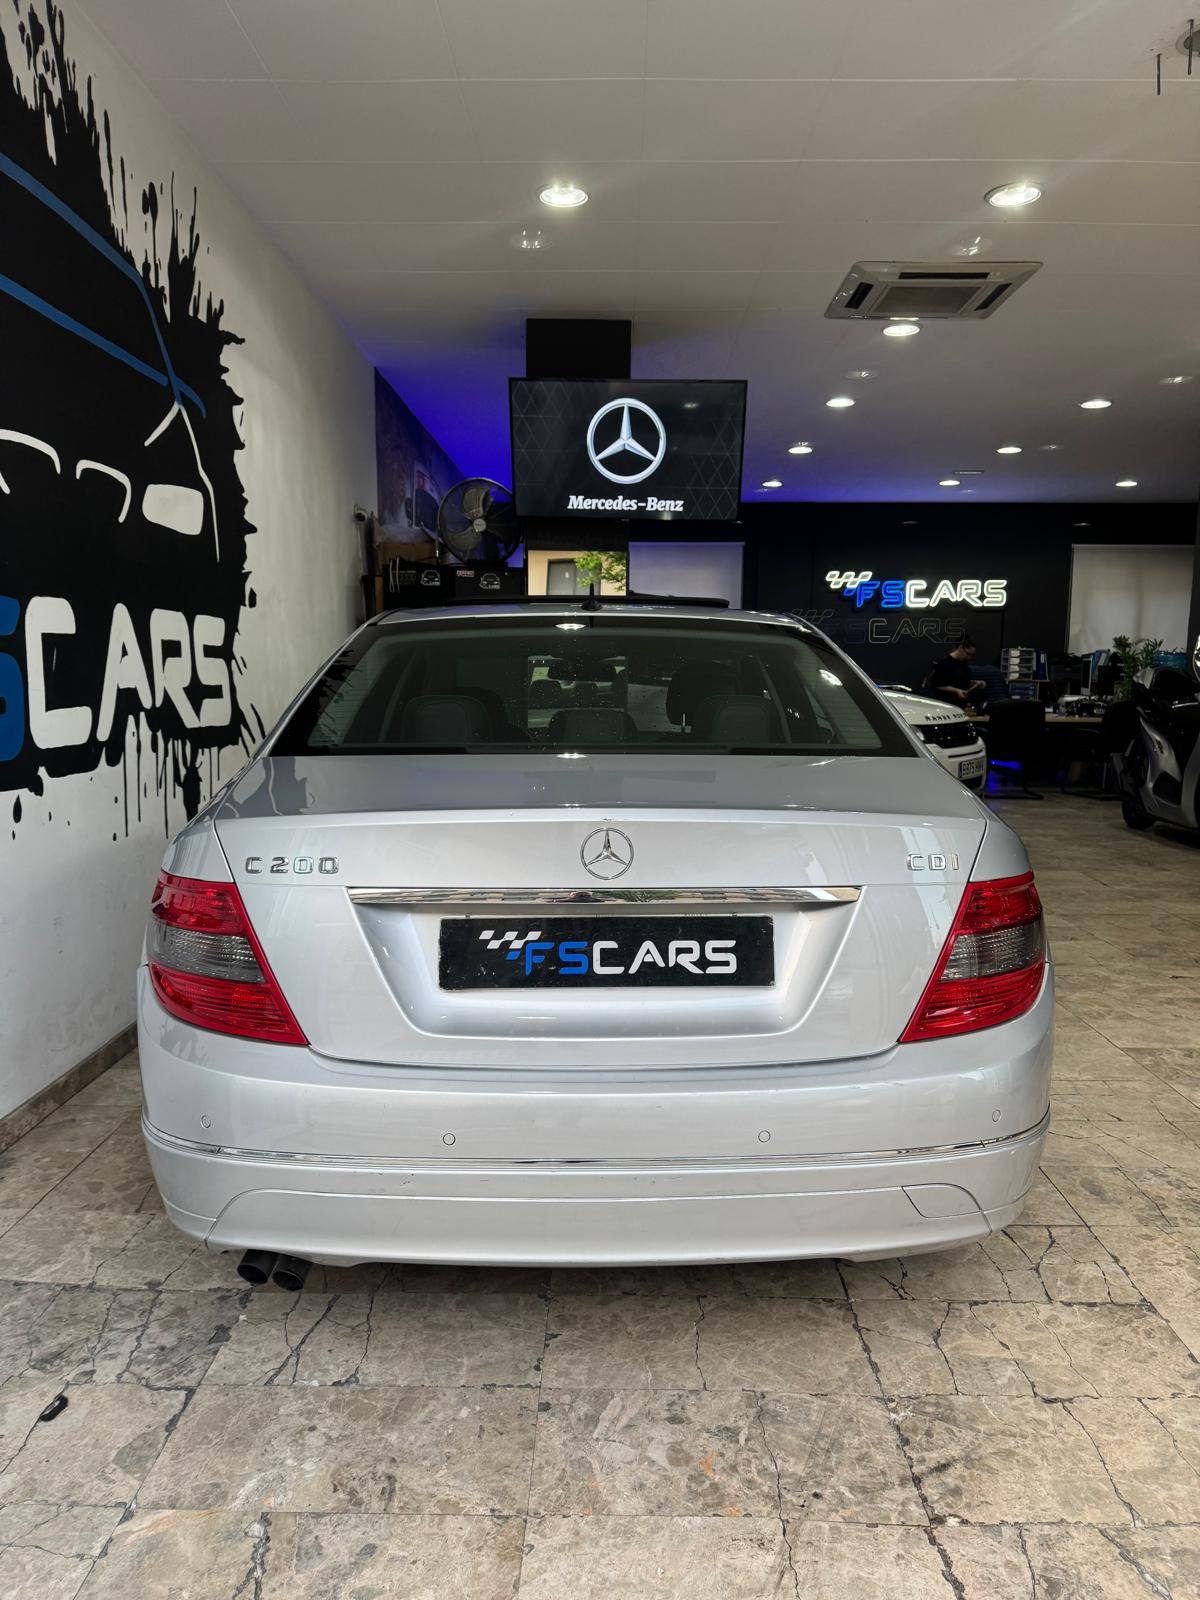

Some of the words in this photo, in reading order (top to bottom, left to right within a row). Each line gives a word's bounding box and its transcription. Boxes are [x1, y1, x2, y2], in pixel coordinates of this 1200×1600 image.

[567, 495, 684, 512] Mercedes-Benz
[856, 579, 1008, 608] FSCARS
[245, 856, 262, 874] C
[270, 856, 340, 874] 200
[906, 853, 960, 871] CDI
[523, 940, 738, 977] FSCARS
